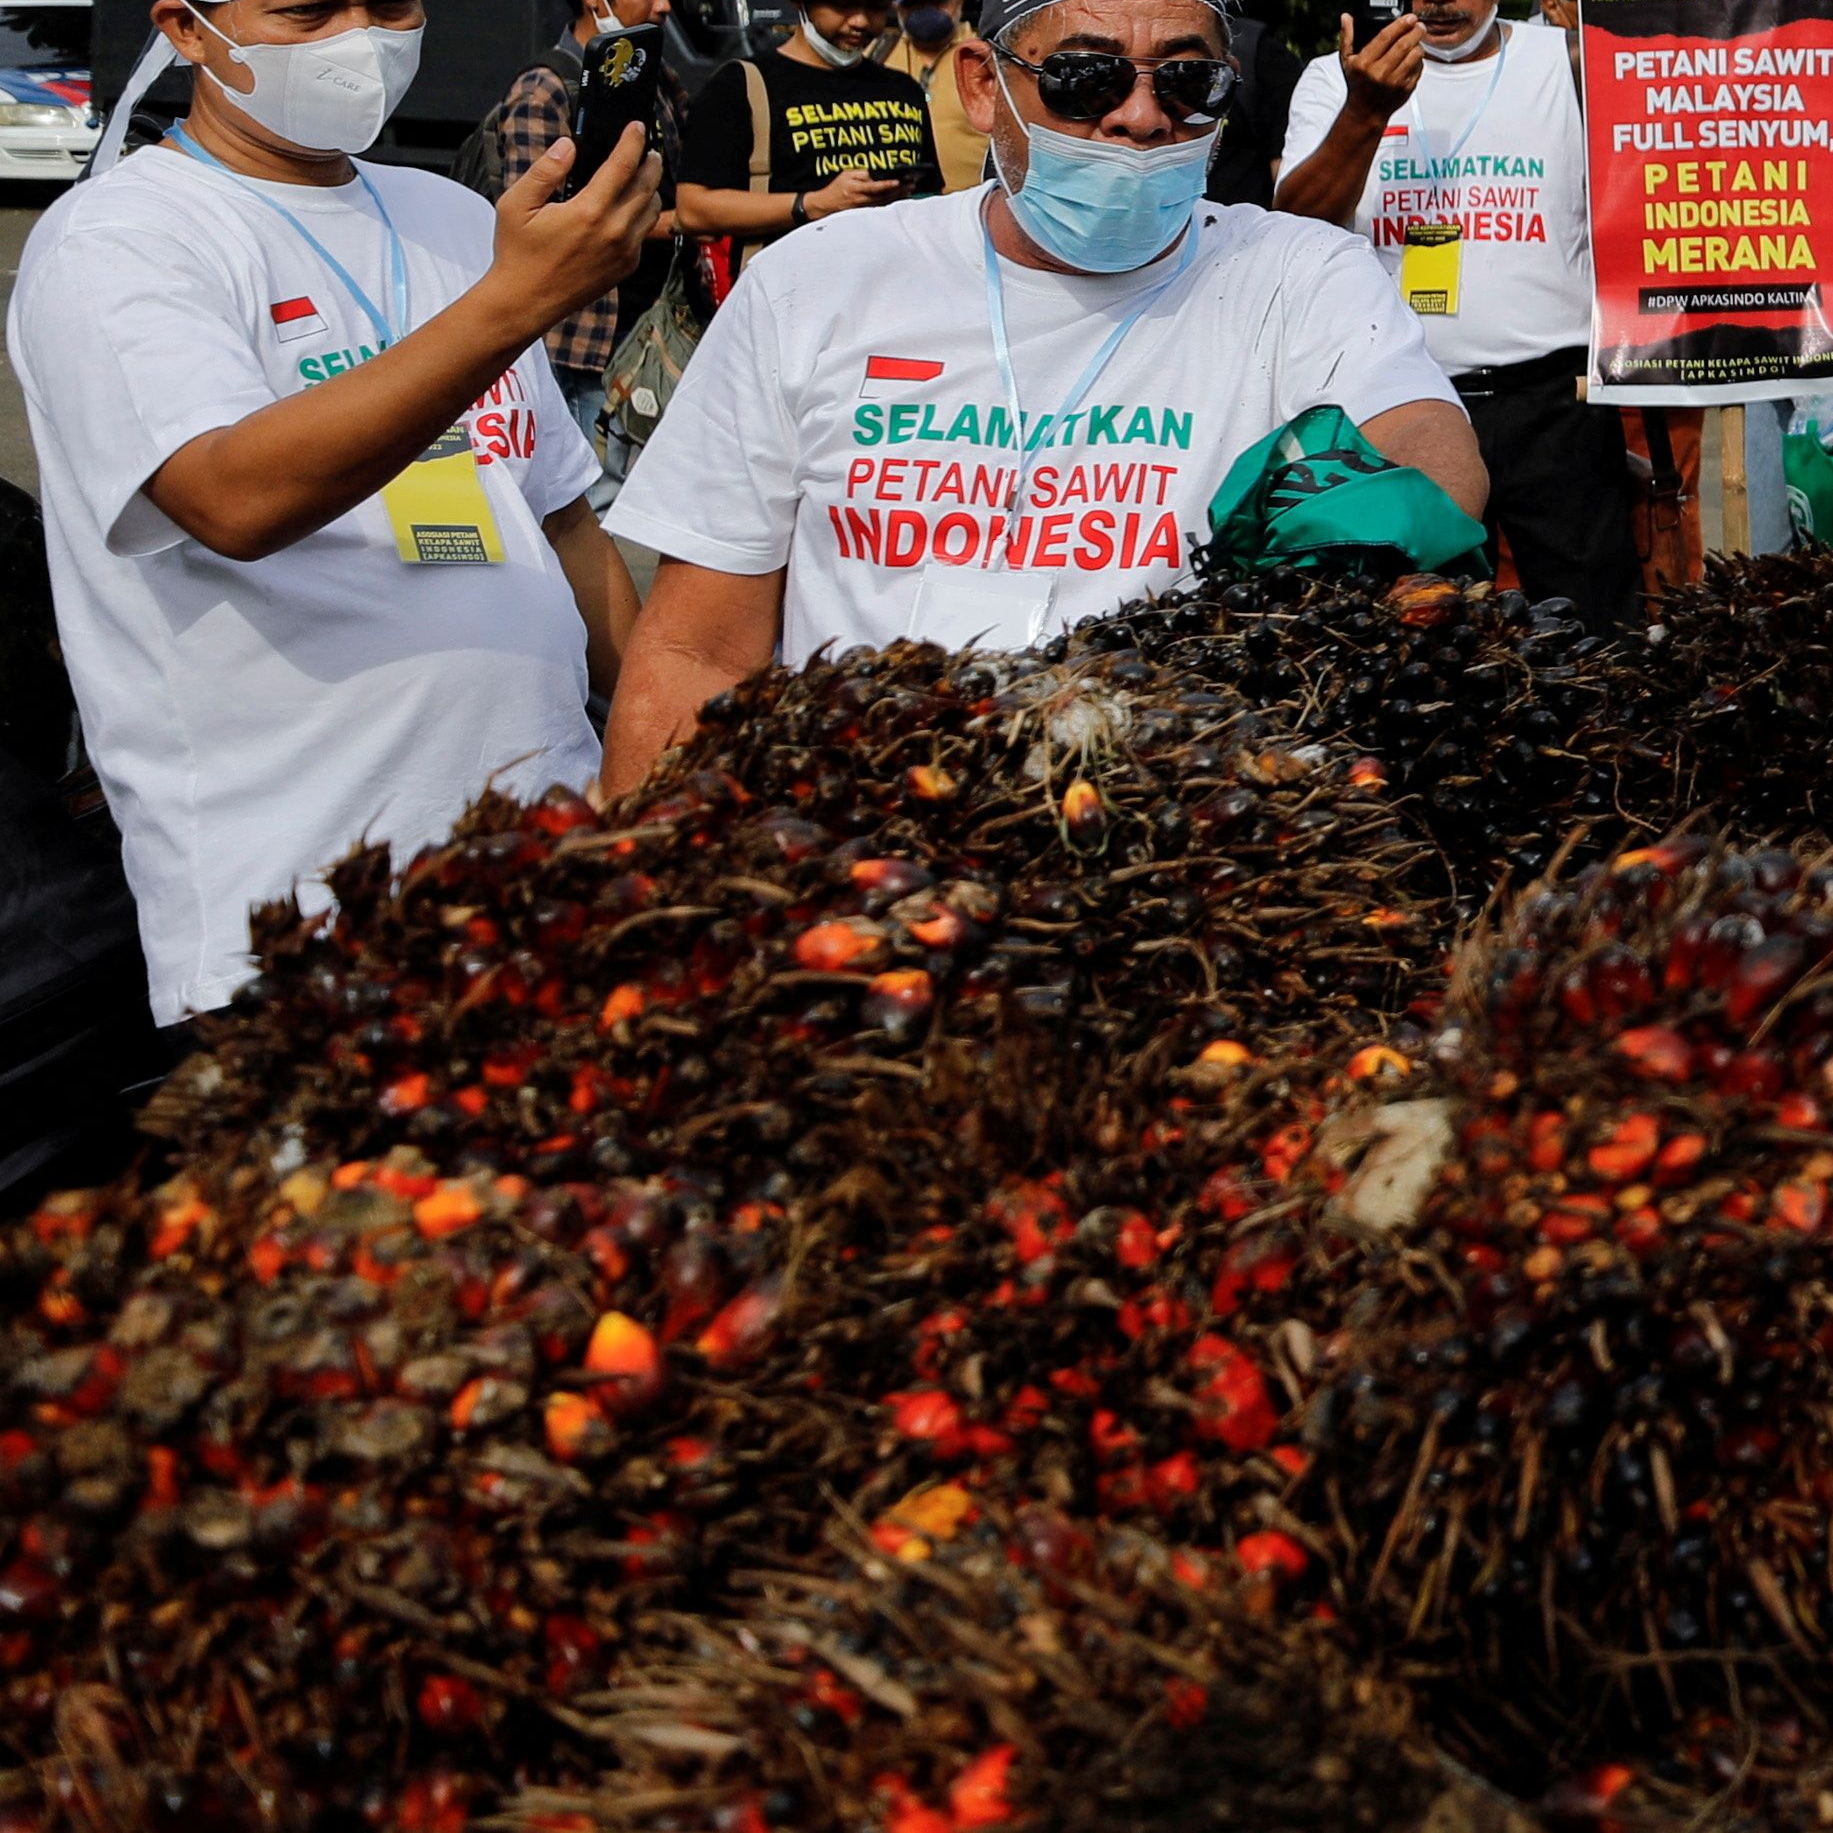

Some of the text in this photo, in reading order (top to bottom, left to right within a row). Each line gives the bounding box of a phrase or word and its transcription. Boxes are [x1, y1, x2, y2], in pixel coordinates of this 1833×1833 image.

[1613, 48, 1728, 80] PETANI
[786, 100, 924, 127] SELAMATKAN
[1645, 82, 1805, 116] MALAYSIA
[792, 125, 875, 154] PETANI
[1612, 121, 1694, 153] FULL
[1379, 154, 1545, 182] SELAMATKAN
[1644, 159, 1808, 195] PETANI
[1382, 184, 1540, 214] PETANI SAWIT
[1644, 198, 1811, 231] INDONESIA
[1642, 233, 1817, 275] MERANA
[1647, 294, 1689, 309] #DPW
[1691, 292, 1765, 307] APKASINDO
[1665, 358, 1705, 369] PETANI
[1708, 357, 1751, 368] KELAPA
[1754, 355, 1790, 365] SAWIT
[852, 403, 1194, 452] SELAMATKAN
[847, 457, 1178, 510] PETANI SAWIT
[828, 504, 1181, 571] INDONESIA
